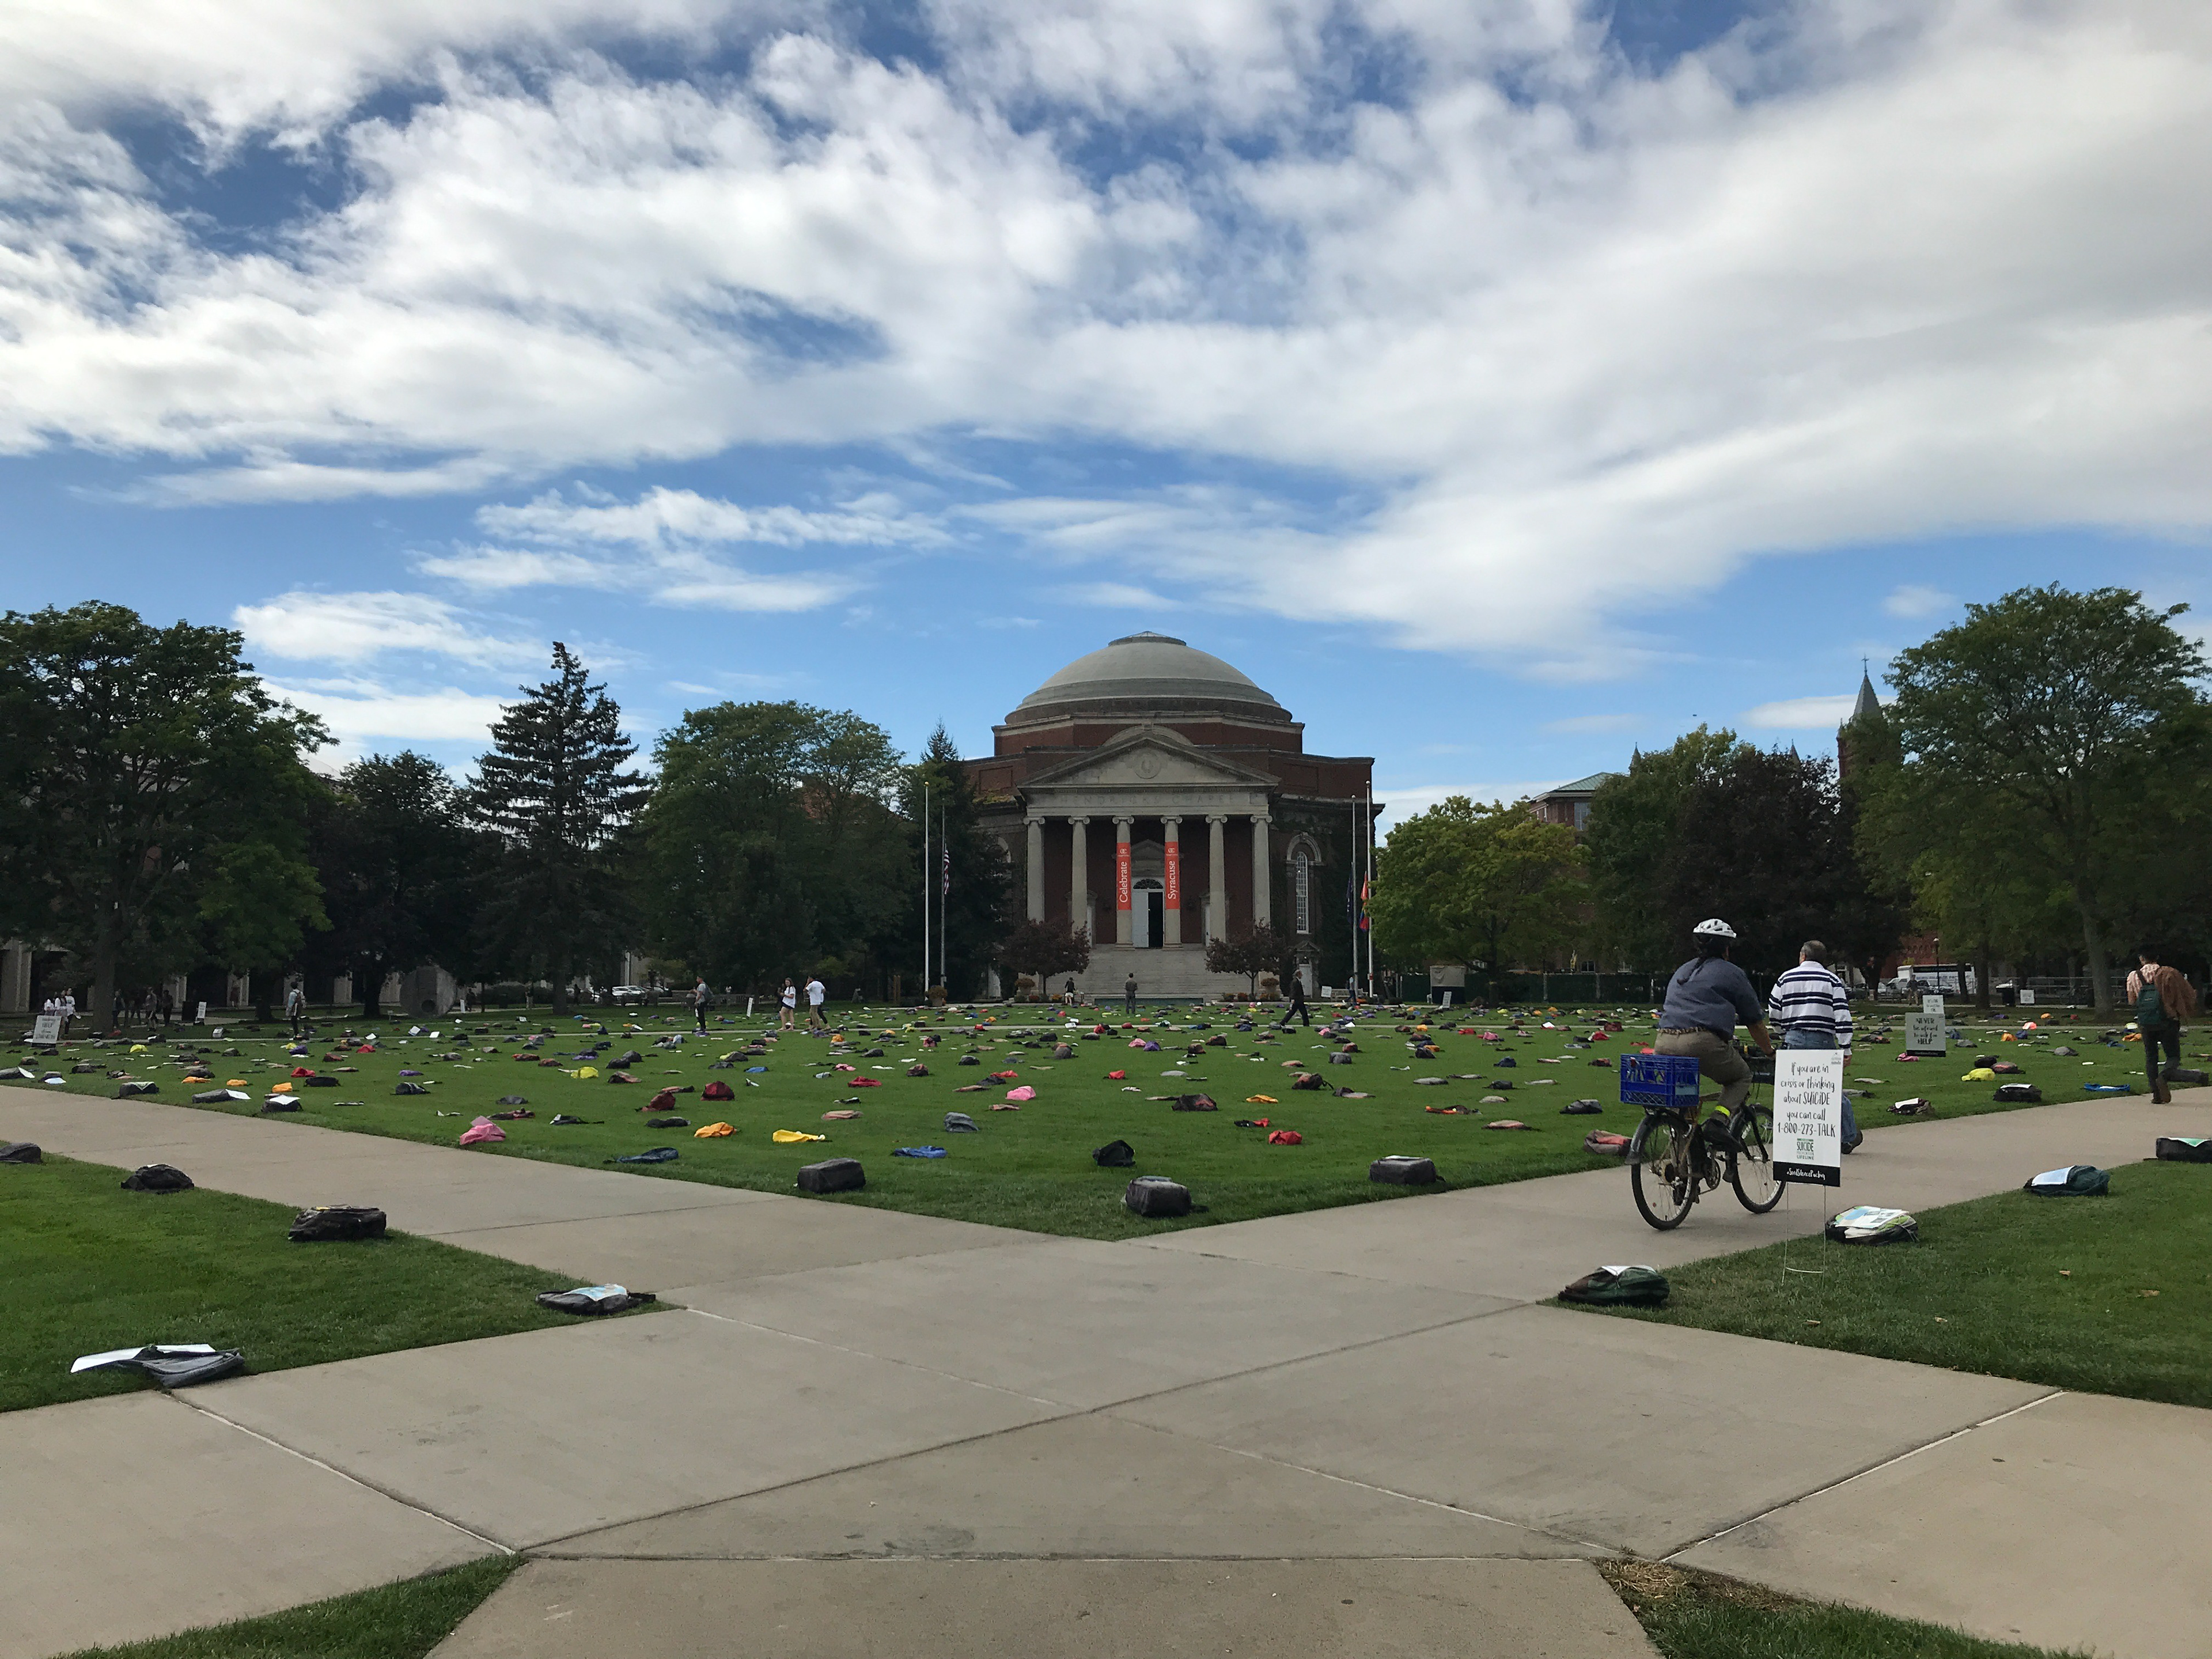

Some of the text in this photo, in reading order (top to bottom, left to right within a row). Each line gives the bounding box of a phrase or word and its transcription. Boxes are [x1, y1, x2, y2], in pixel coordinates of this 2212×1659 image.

[1119, 861, 1128, 903] Celebrate
[1168, 861, 1177, 899] Syracuse
[1791, 1062, 1829, 1075] If you are in
[1781, 1078, 1797, 1088] crisis
[1807, 1076, 1835, 1093] thinking
[1783, 1091, 1801, 1104] about
[1787, 1108, 1825, 1122] you can call
[1778, 1122, 1836, 1138] 1-800-273-TALK
[1797, 1141, 1814, 1152] SUICIDE
